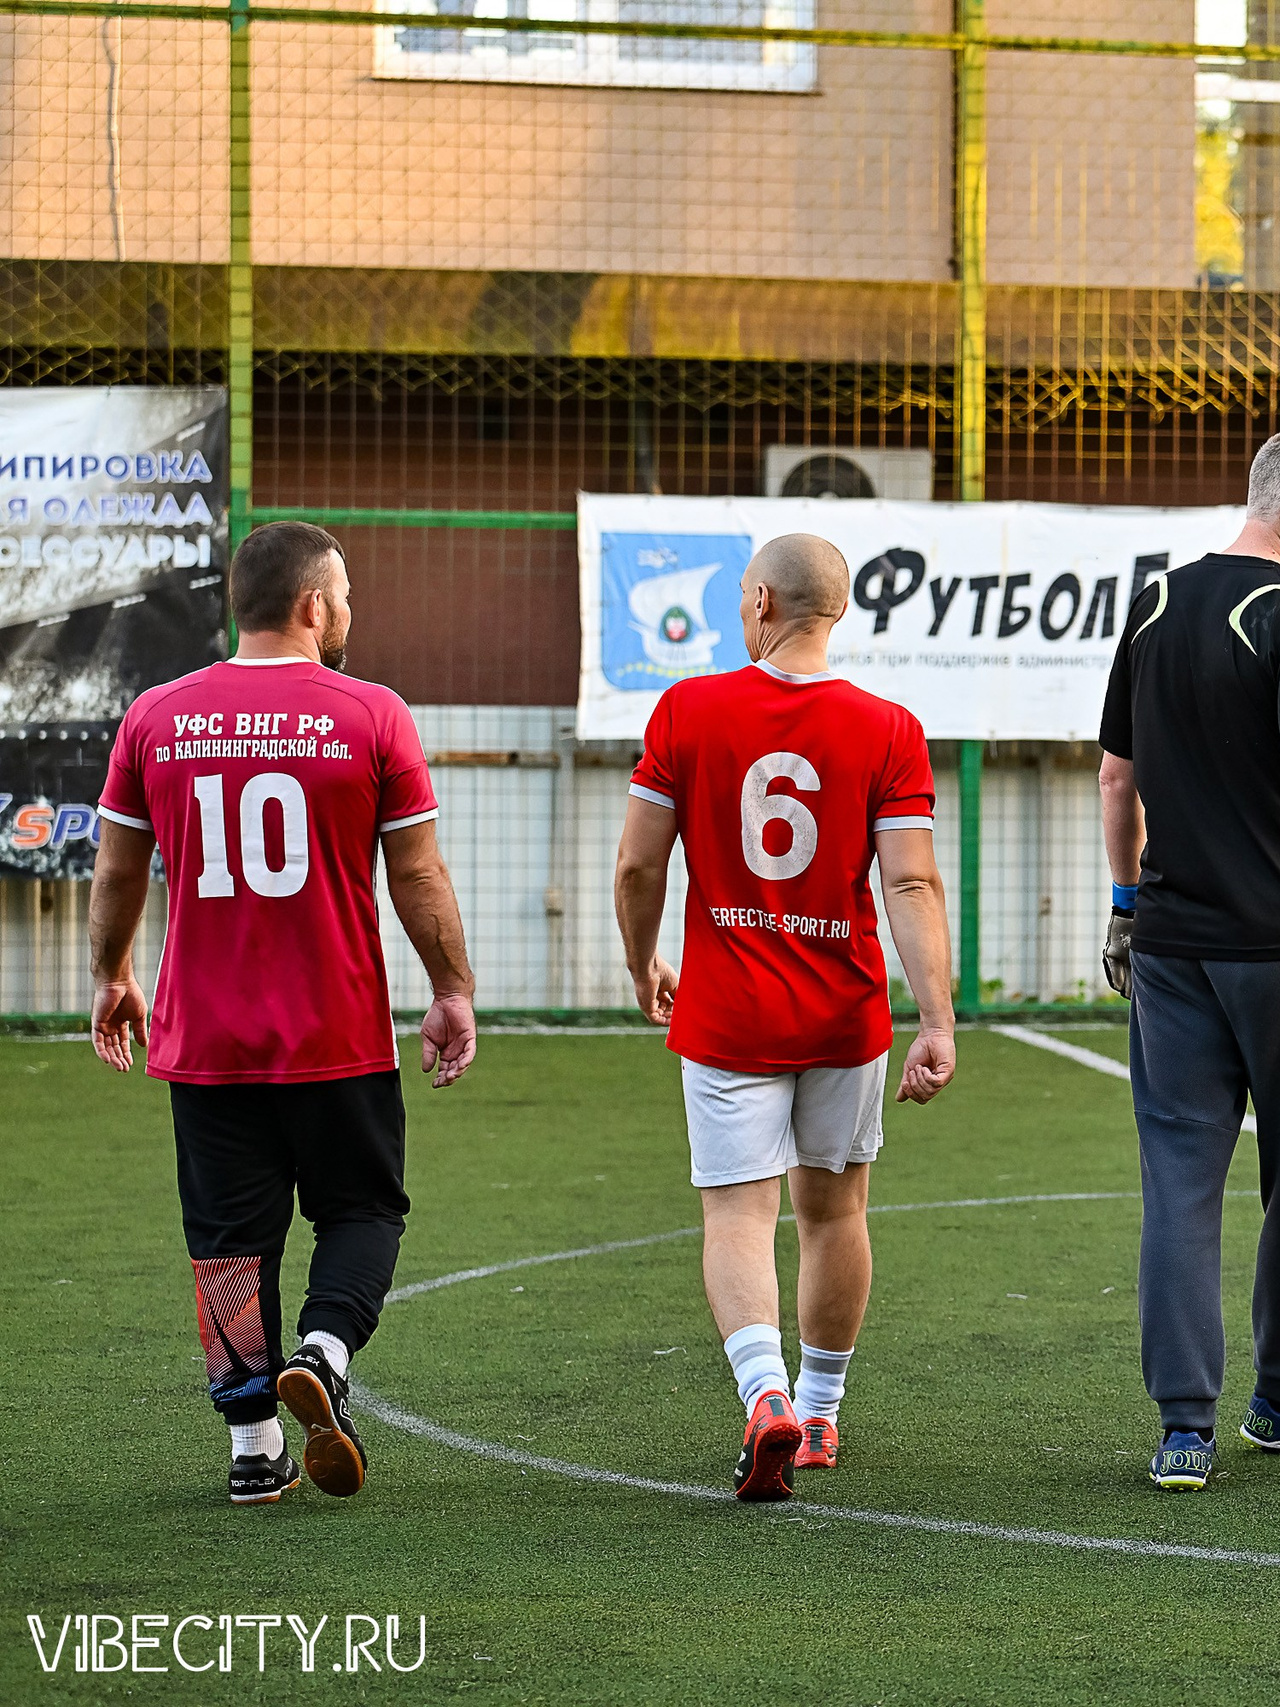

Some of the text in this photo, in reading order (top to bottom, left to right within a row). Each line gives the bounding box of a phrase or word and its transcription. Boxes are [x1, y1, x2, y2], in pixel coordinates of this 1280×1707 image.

[173, 713, 335, 737] УФС ВНГ РФ
[156, 736, 352, 763] по КАЛИНИНГРАДСКОЙ обл.
[740, 751, 821, 880] 6
[194, 772, 309, 898] 10
[709, 907, 850, 939] ERFECTEE-SPORT.RU
